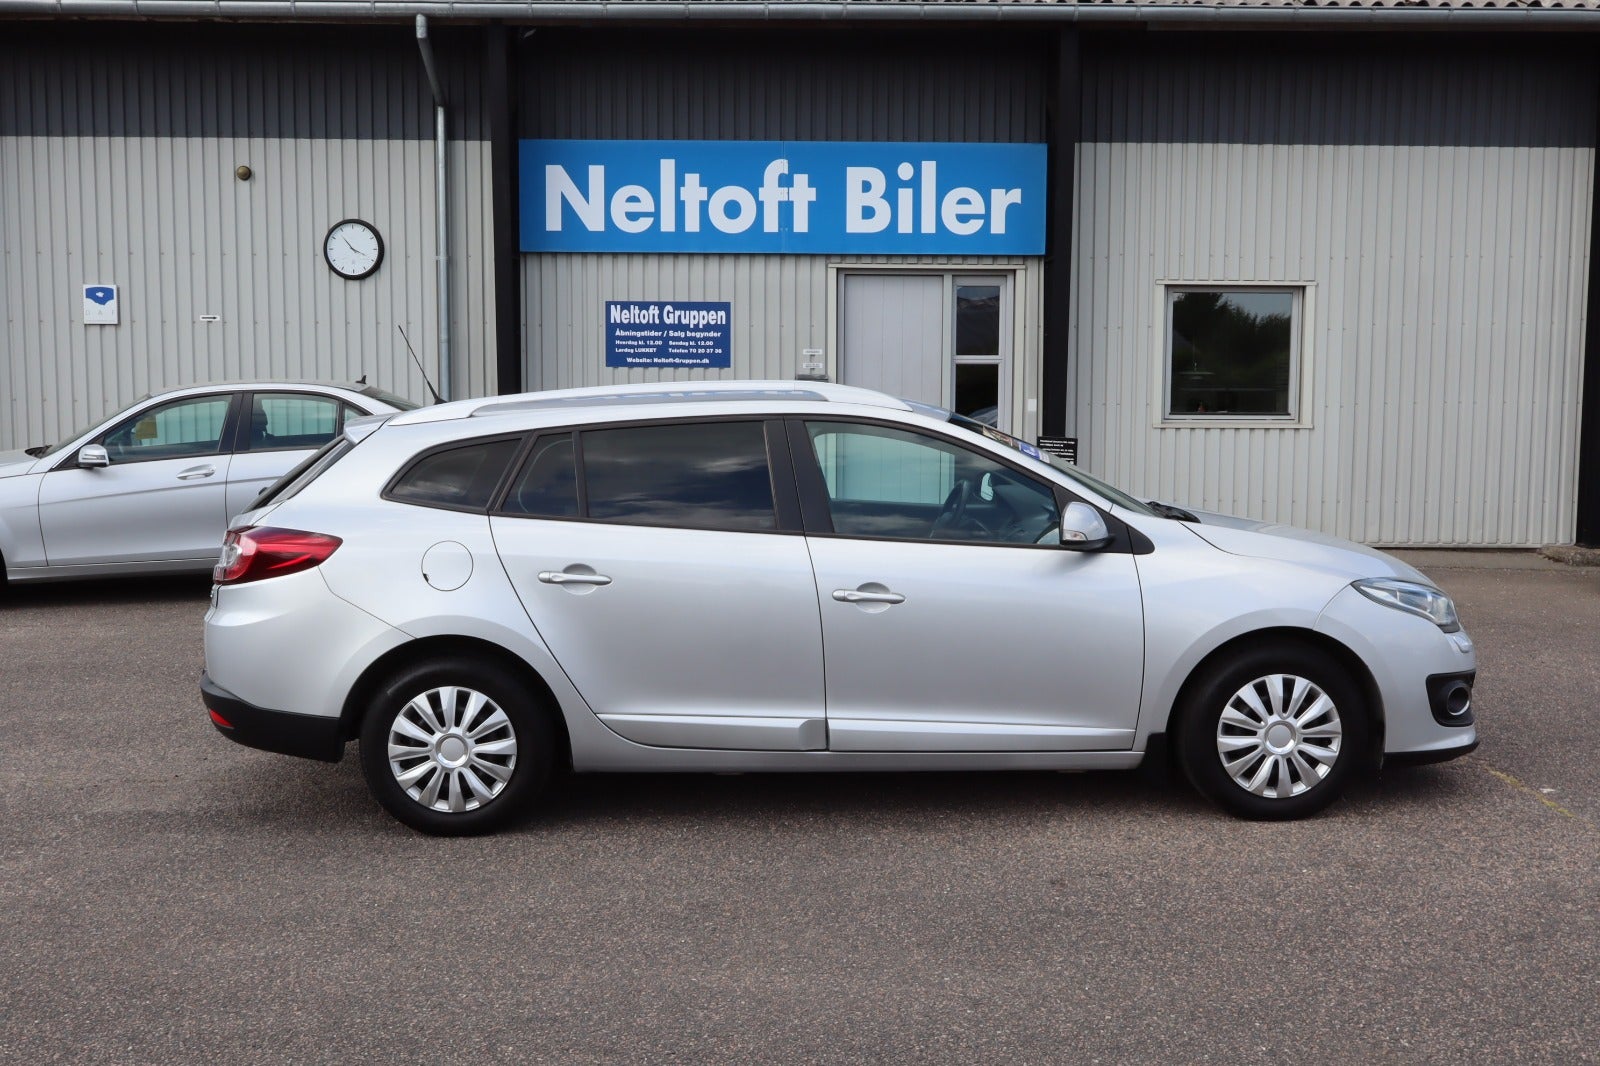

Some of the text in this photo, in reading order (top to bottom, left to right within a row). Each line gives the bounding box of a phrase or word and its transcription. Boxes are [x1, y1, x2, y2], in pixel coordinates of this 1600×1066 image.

[545, 158, 1022, 235] Neltoft Biler
[610, 304, 726, 329] Neltoft Gruppen
[615, 328, 662, 338] Åbningstider
[668, 330, 685, 338] Salg
[686, 330, 721, 339] begynder
[653, 357, 710, 365] Neltoft-Gruppen.dk
